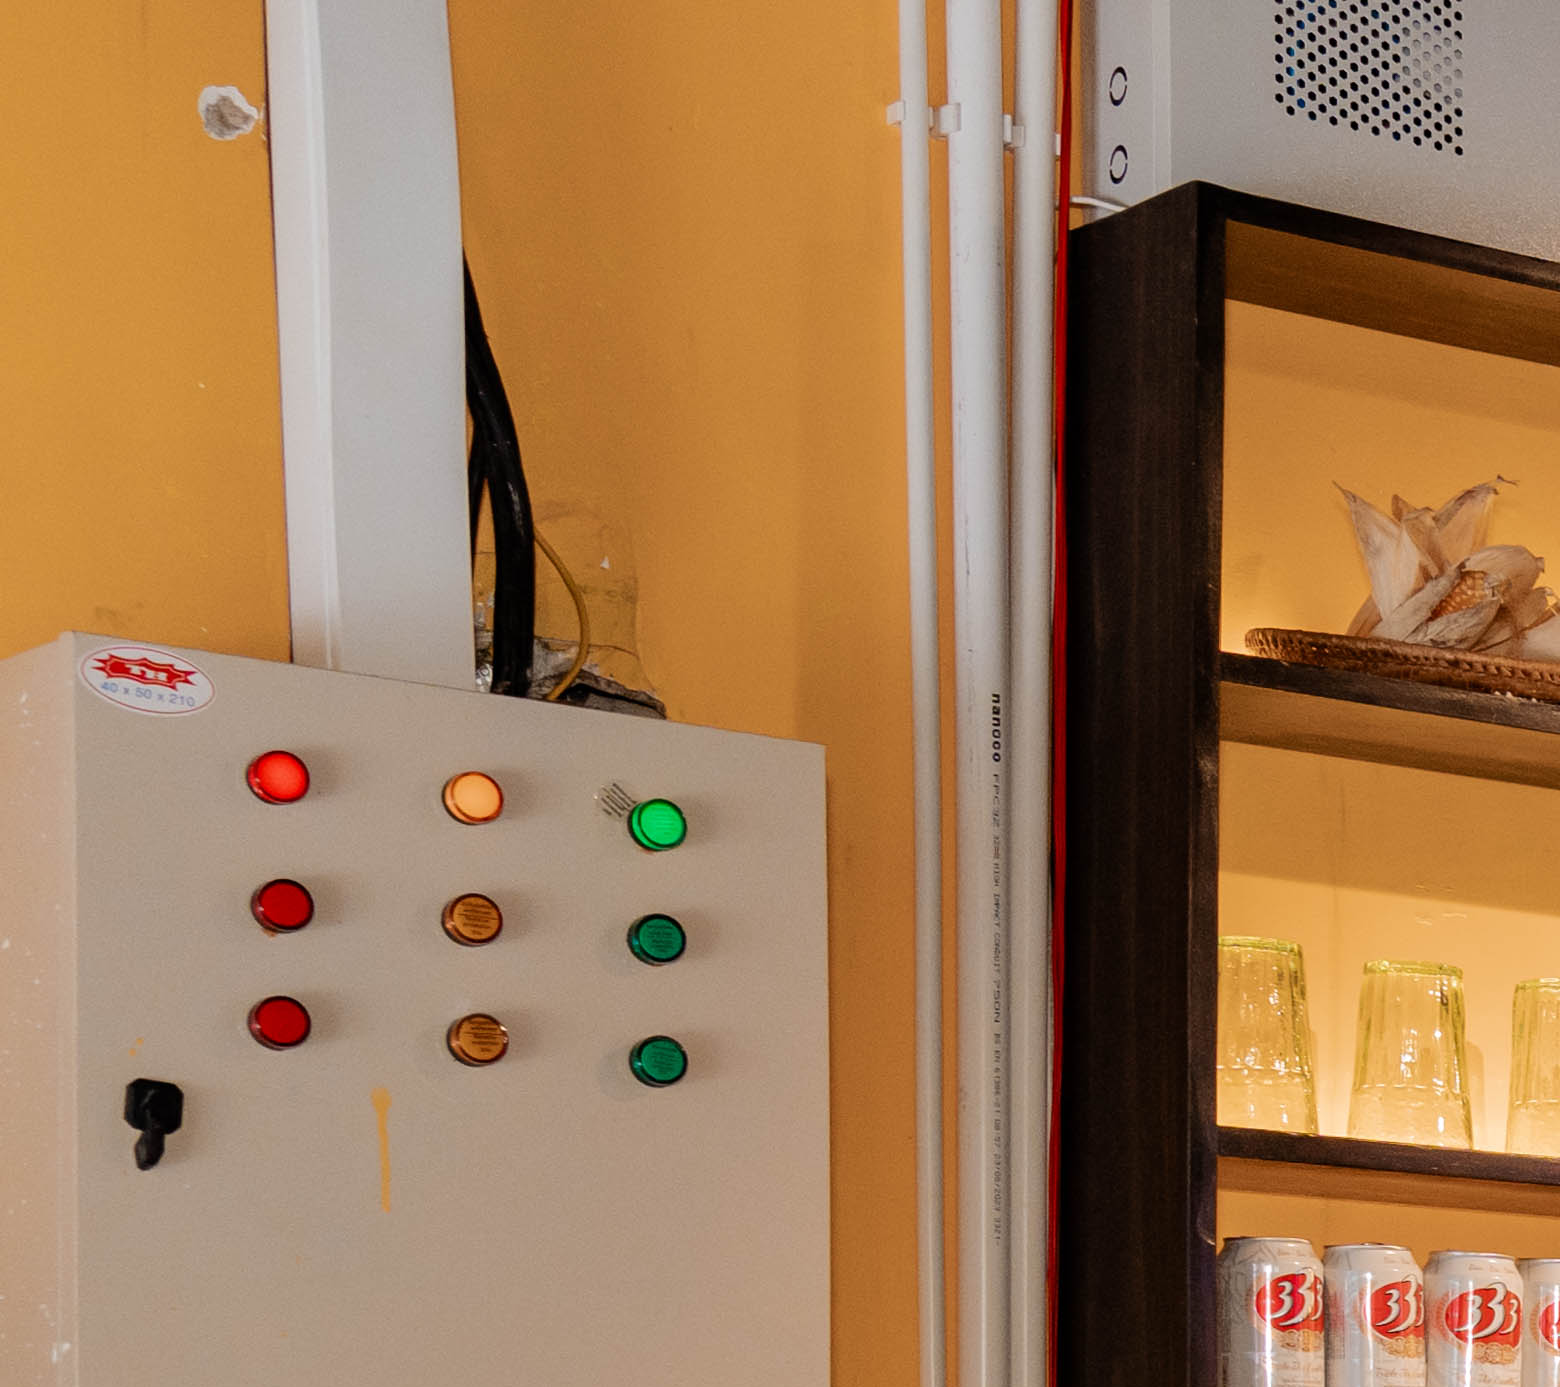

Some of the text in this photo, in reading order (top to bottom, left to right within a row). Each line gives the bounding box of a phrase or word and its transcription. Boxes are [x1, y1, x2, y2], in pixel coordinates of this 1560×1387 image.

[135, 687, 152, 699] 50
[169, 693, 196, 707] 210
[1454, 1282, 1519, 1339] 333
